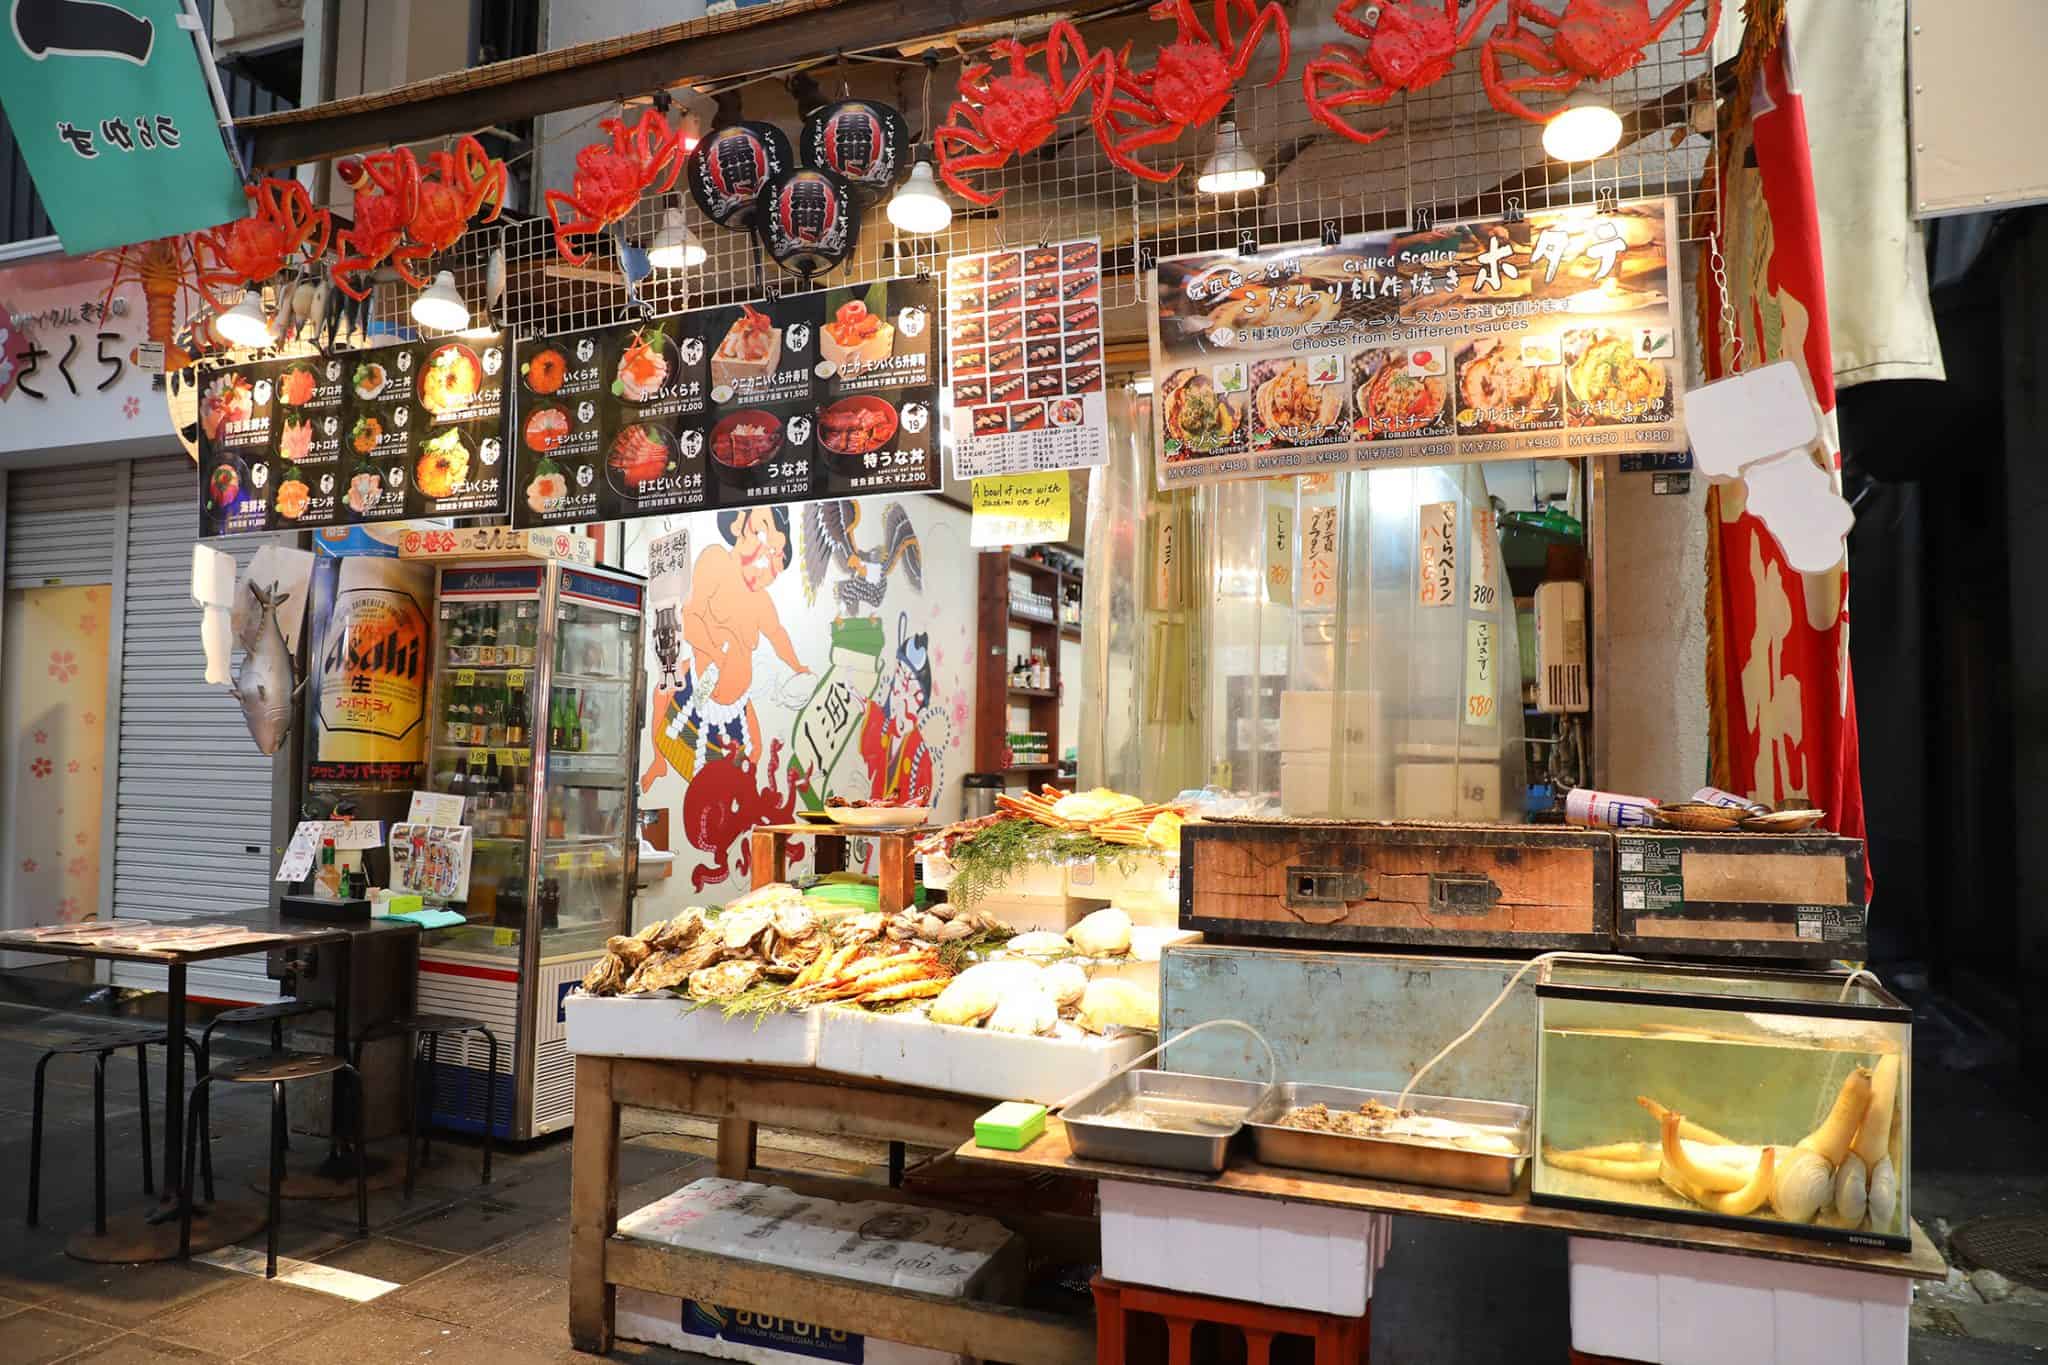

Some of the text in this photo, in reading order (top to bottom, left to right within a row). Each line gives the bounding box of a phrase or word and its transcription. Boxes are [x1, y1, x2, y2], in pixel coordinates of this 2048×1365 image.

[1343, 249, 1457, 273] Grilled Scallop
[1472, 221, 1627, 293] ホタテ
[1243, 267, 1460, 313] こだわり創作焼き
[1292, 320, 1528, 351] Choose from 5 different sauces
[16, 333, 122, 398] さくら
[563, 367, 599, 383] いくら丼
[639, 382, 701, 403] カニいくら丼
[677, 401, 703, 413] ¥2,000
[1474, 404, 1559, 422] カルボナーラ
[1582, 399, 1664, 415] ネギしょうゆ
[1368, 411, 1445, 430] トマトチーズ
[1513, 420, 1563, 430] Carbonara
[1621, 413, 1670, 424] Soy Sauce
[1294, 433, 1349, 447] Peperoncino
[1383, 428, 1453, 440] Tomato&Cheese
[864, 448, 925, 468] 特うな丼
[768, 460, 809, 478] うな丼
[895, 471, 926, 483] ¥2,200
[638, 474, 702, 493] 甘エビいくら丼
[781, 482, 808, 494] ¥1,200
[973, 483, 980, 498] A
[983, 483, 1002, 497] bowl
[1036, 482, 1061, 493] with
[1473, 585, 1495, 603] 380
[325, 623, 419, 680] Asahi
[351, 674, 372, 694] 生
[335, 696, 393, 714] スーパードライ
[1469, 695, 1492, 717] 580
